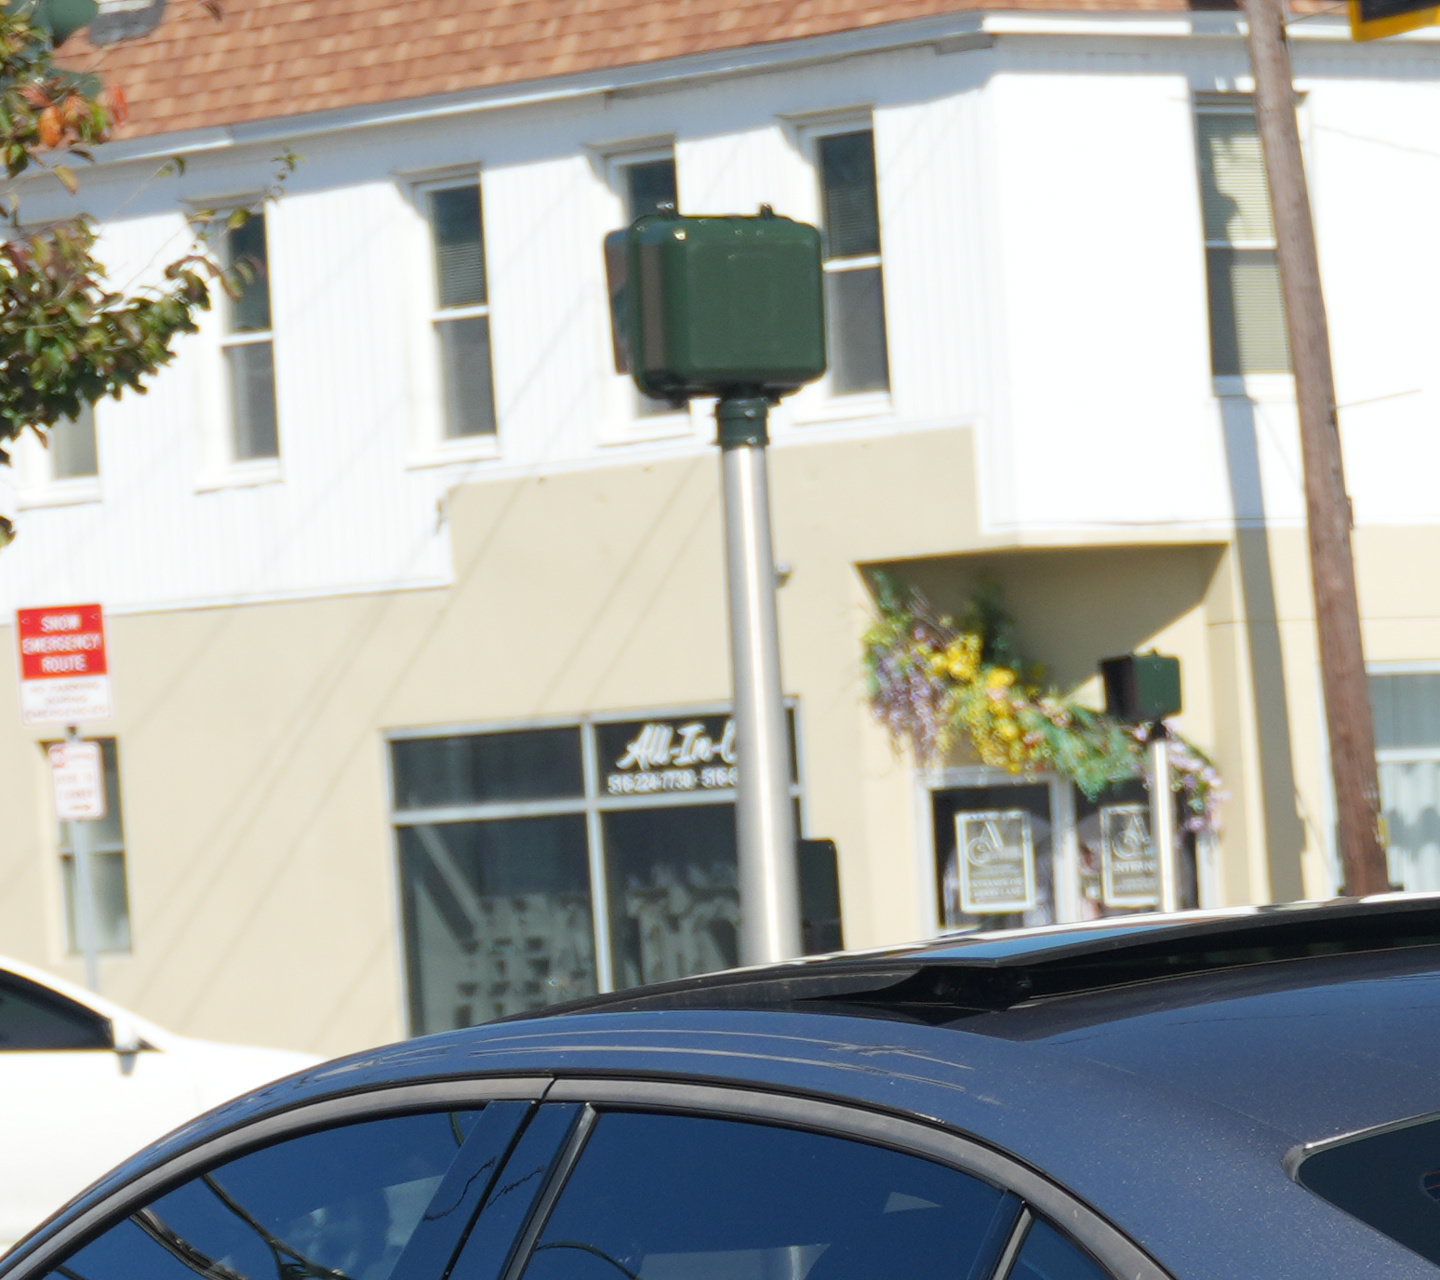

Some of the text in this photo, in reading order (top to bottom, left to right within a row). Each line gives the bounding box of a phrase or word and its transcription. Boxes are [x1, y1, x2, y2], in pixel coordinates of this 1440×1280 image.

[40, 613, 82, 632] SNOW
[22, 633, 101, 655] EMERGENCY
[41, 653, 88, 673] ROUTE
